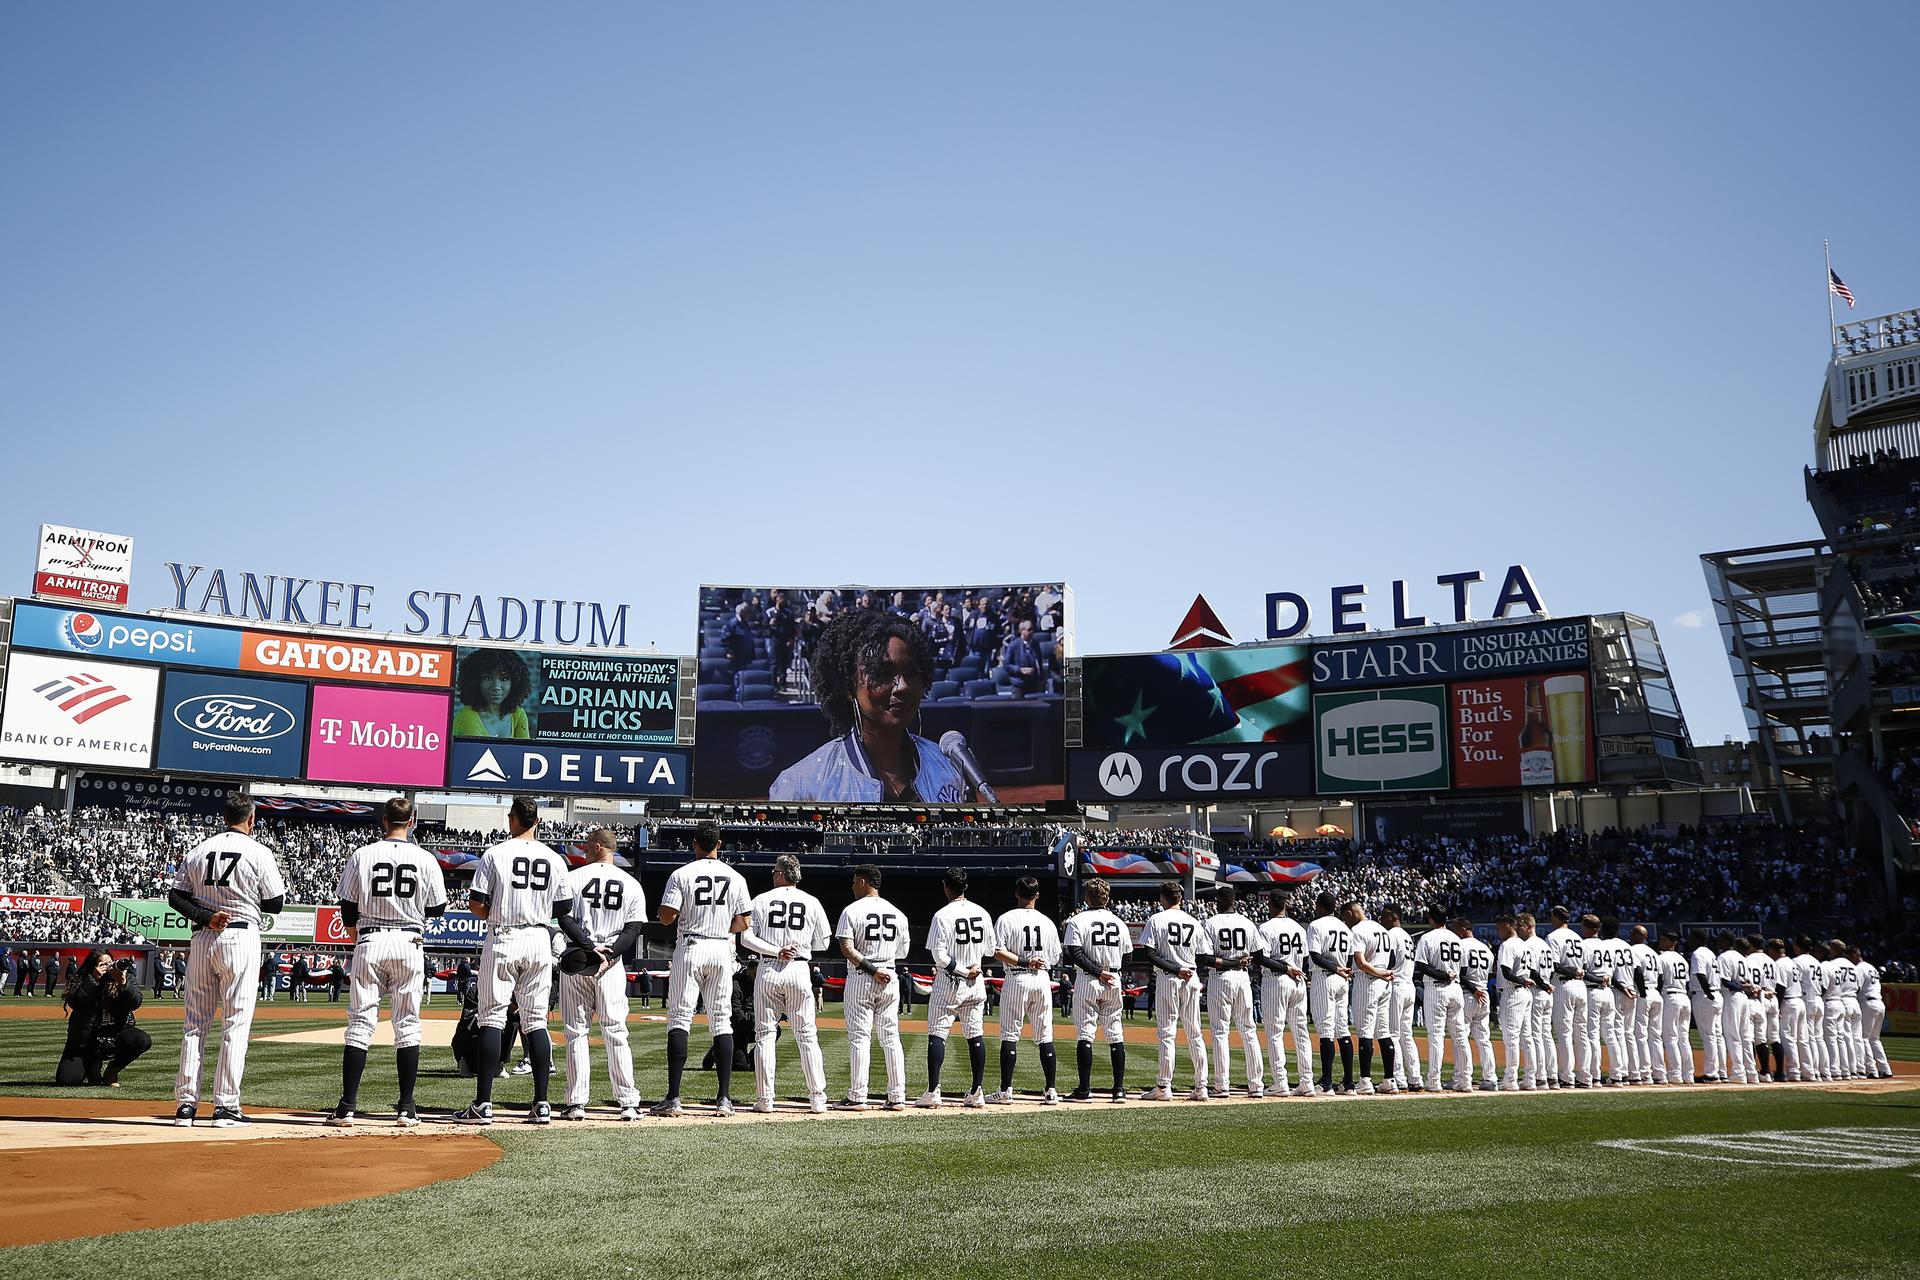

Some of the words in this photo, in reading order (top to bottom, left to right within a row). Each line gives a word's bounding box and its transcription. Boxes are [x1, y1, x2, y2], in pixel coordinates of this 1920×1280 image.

[45, 532, 128, 554] ARMITRON
[45, 576, 121, 596] ARMITRON
[81, 590, 118, 601] WATCHES
[164, 561, 375, 630] YANKEE
[404, 590, 631, 648] STADIUM
[1266, 564, 1550, 639] DELTA
[1462, 624, 1586, 653] INSURANCE
[256, 640, 440, 679] GATORADE
[543, 658, 623, 673] PERFORMING
[626, 663, 676, 674] TODAY'S
[1313, 643, 1447, 683] STARR
[1462, 642, 1588, 671] COMPANIES
[549, 670, 610, 682] NATIONAL
[613, 672, 670, 684] ANTHEM:
[541, 686, 674, 710] ADRIANNA
[1457, 687, 1503, 706] This
[195, 698, 276, 735] Ford
[572, 708, 642, 731] HICKS
[1459, 705, 1513, 724] Bud's
[4, 732, 47, 746] BANK
[53, 736, 72, 747] OF
[77, 738, 149, 754] AMERICA
[351, 719, 439, 751] Mobile
[538, 730, 559, 738] FROM
[561, 731, 581, 739] SOME
[622, 733, 633, 741] ON
[634, 734, 674, 742] BROADWAY
[1328, 722, 1435, 757] HESS
[1460, 726, 1494, 743] For
[193, 740, 271, 755] BuyFordNow.com
[1461, 745, 1503, 762] You.
[522, 752, 676, 785] DELTA
[1159, 752, 1279, 791] razr
[124, 794, 141, 804] New
[141, 796, 160, 808] York
[161, 797, 192, 809] Yankees
[204, 851, 242, 886] 17
[372, 862, 418, 898] 26
[511, 856, 551, 891] 99
[581, 877, 625, 911] 48
[694, 875, 731, 906] 27
[114, 909, 159, 927] Uber
[768, 899, 806, 931] 28
[864, 913, 897, 942] 25
[955, 916, 984, 945] 95
[1023, 925, 1043, 951] 11
[1091, 921, 1120, 947] 22
[1167, 922, 1195, 948] 97
[1218, 927, 1246, 951] 90
[1279, 931, 1302, 955] 84
[1329, 930, 1348, 953] 76
[1373, 932, 1390, 953] 70
[1439, 941, 1461, 962] 66
[1565, 939, 1583, 958] 35
[1468, 949, 1489, 969] 65
[1540, 950, 1552, 968] 36
[1594, 949, 1613, 968] 34
[1615, 949, 1634, 967] 33
[1645, 953, 1658, 972] 31
[1673, 962, 1690, 980] 12
[1763, 963, 1775, 980] 41
[1809, 965, 1822, 982] 74
[1840, 966, 1857, 983] 75
